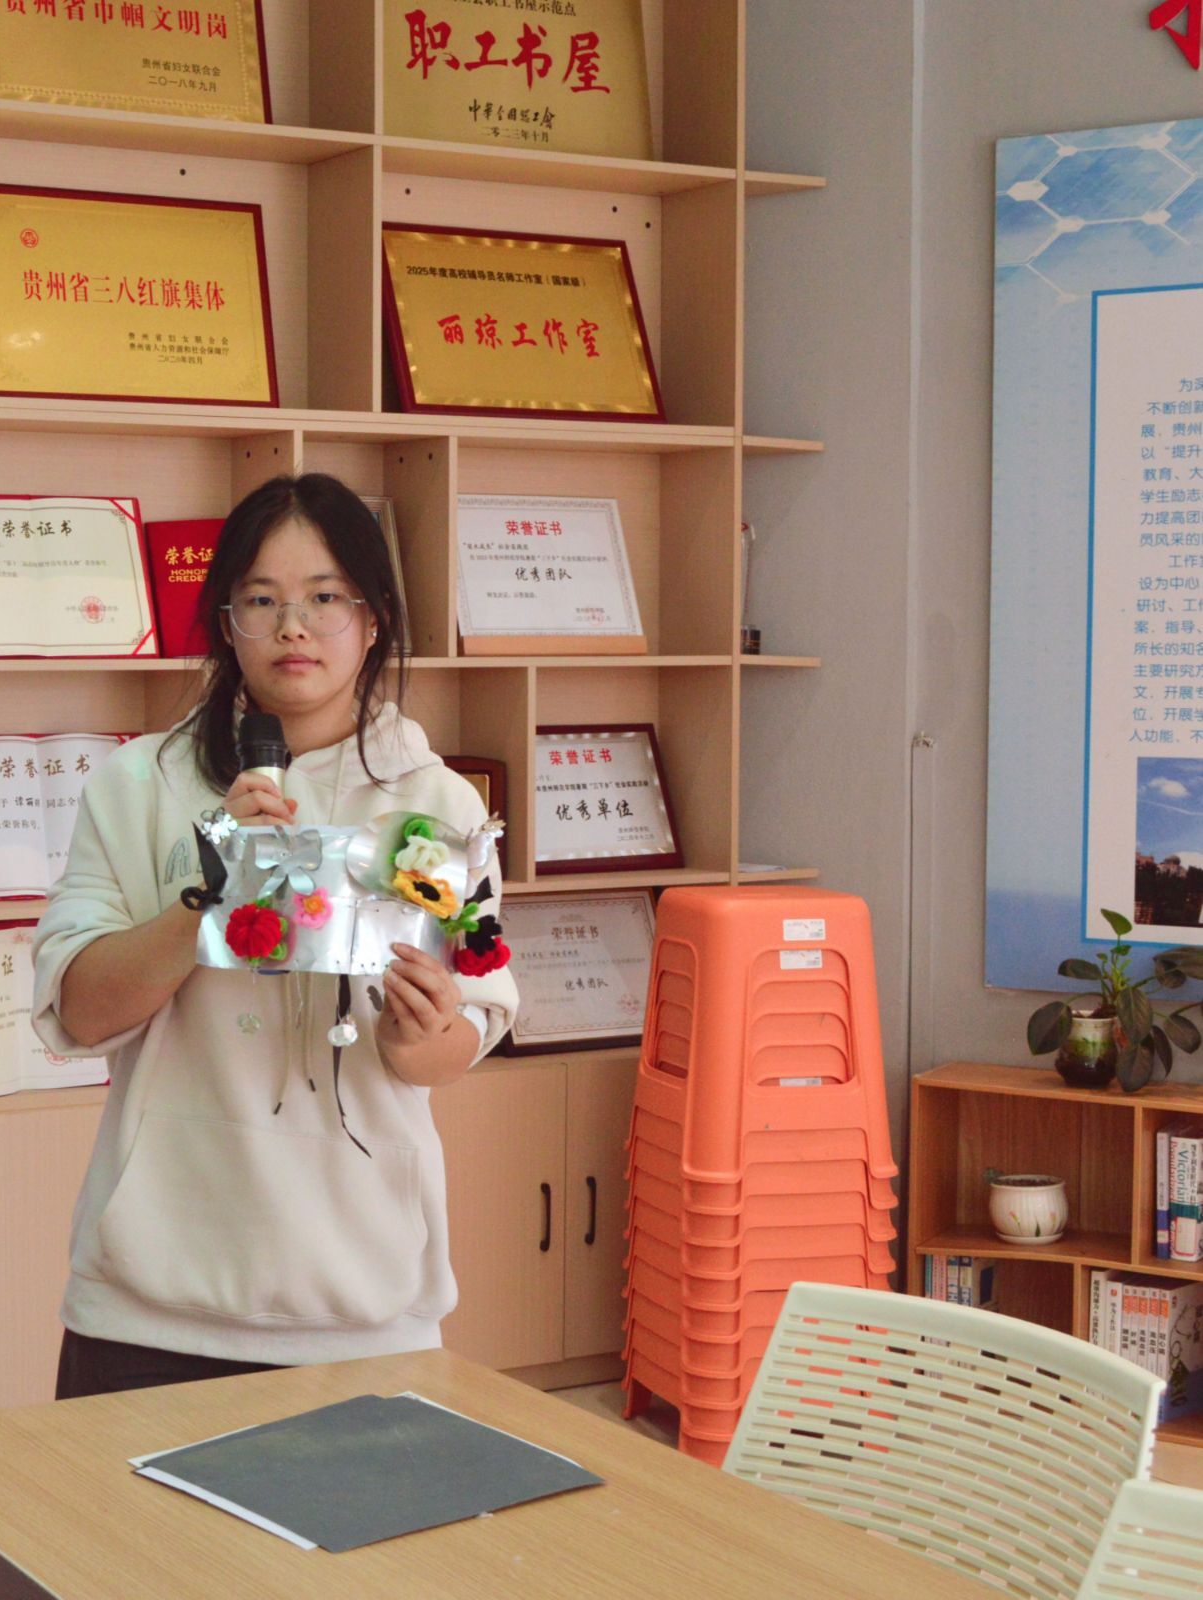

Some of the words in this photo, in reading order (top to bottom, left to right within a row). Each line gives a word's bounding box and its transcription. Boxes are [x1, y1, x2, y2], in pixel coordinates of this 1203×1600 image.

[405, 9, 611, 94] 职工书屋
[142, 58, 221, 77] 贵州省妇女联合会
[22, 269, 226, 312] 贵州省三八红旗集体
[437, 313, 601, 358] 丽琼工作室
[504, 520, 563, 536] 荣誉证书
[1140, 511, 1203, 526] 力提高团
[1, 519, 74, 538] 荣誉证书
[1140, 532, 1203, 548] 员风采的
[168, 575, 206, 583] CREDE
[515, 566, 572, 582] 优秀团队
[549, 747, 613, 766] 荣誉证书
[556, 798, 633, 821] 优秀单位
